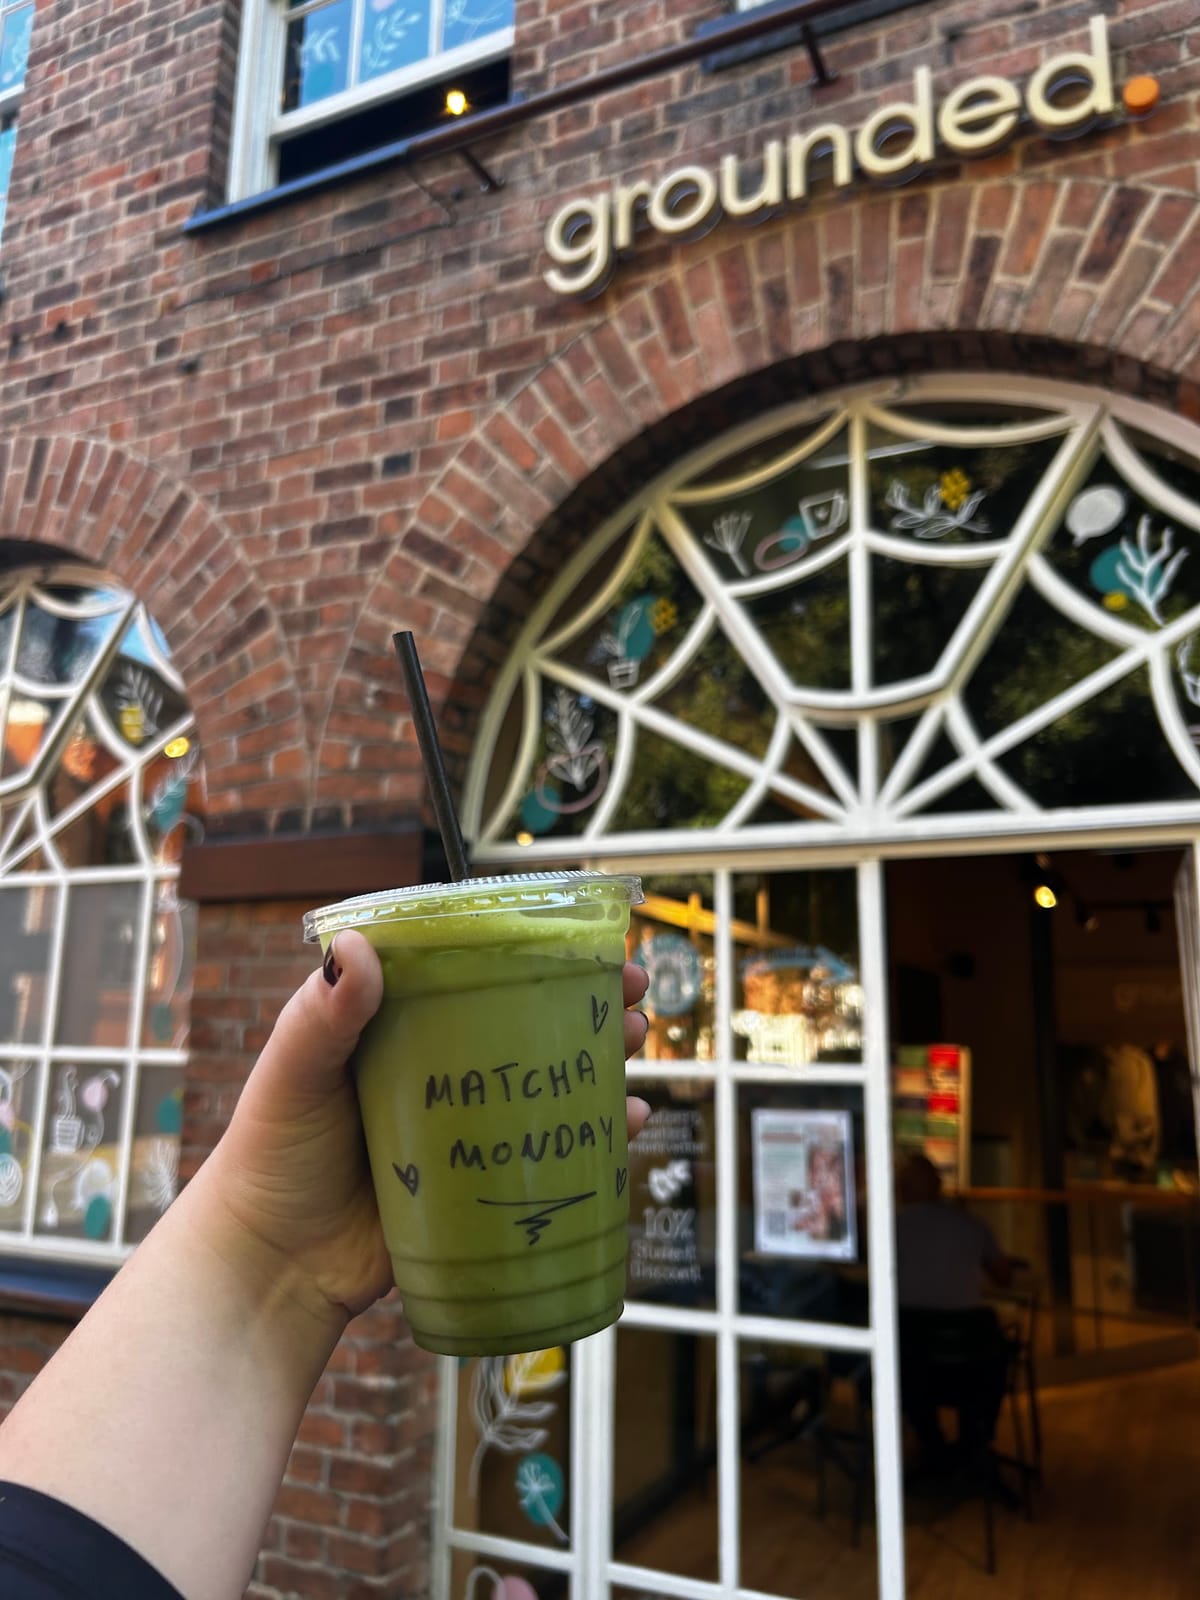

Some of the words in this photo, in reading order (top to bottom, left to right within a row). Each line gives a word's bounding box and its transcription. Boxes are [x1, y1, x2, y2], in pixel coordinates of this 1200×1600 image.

[425, 1049, 596, 1109] MATCHA
[450, 1116, 612, 1170] MONDAY
[643, 1207, 697, 1239] 10%
